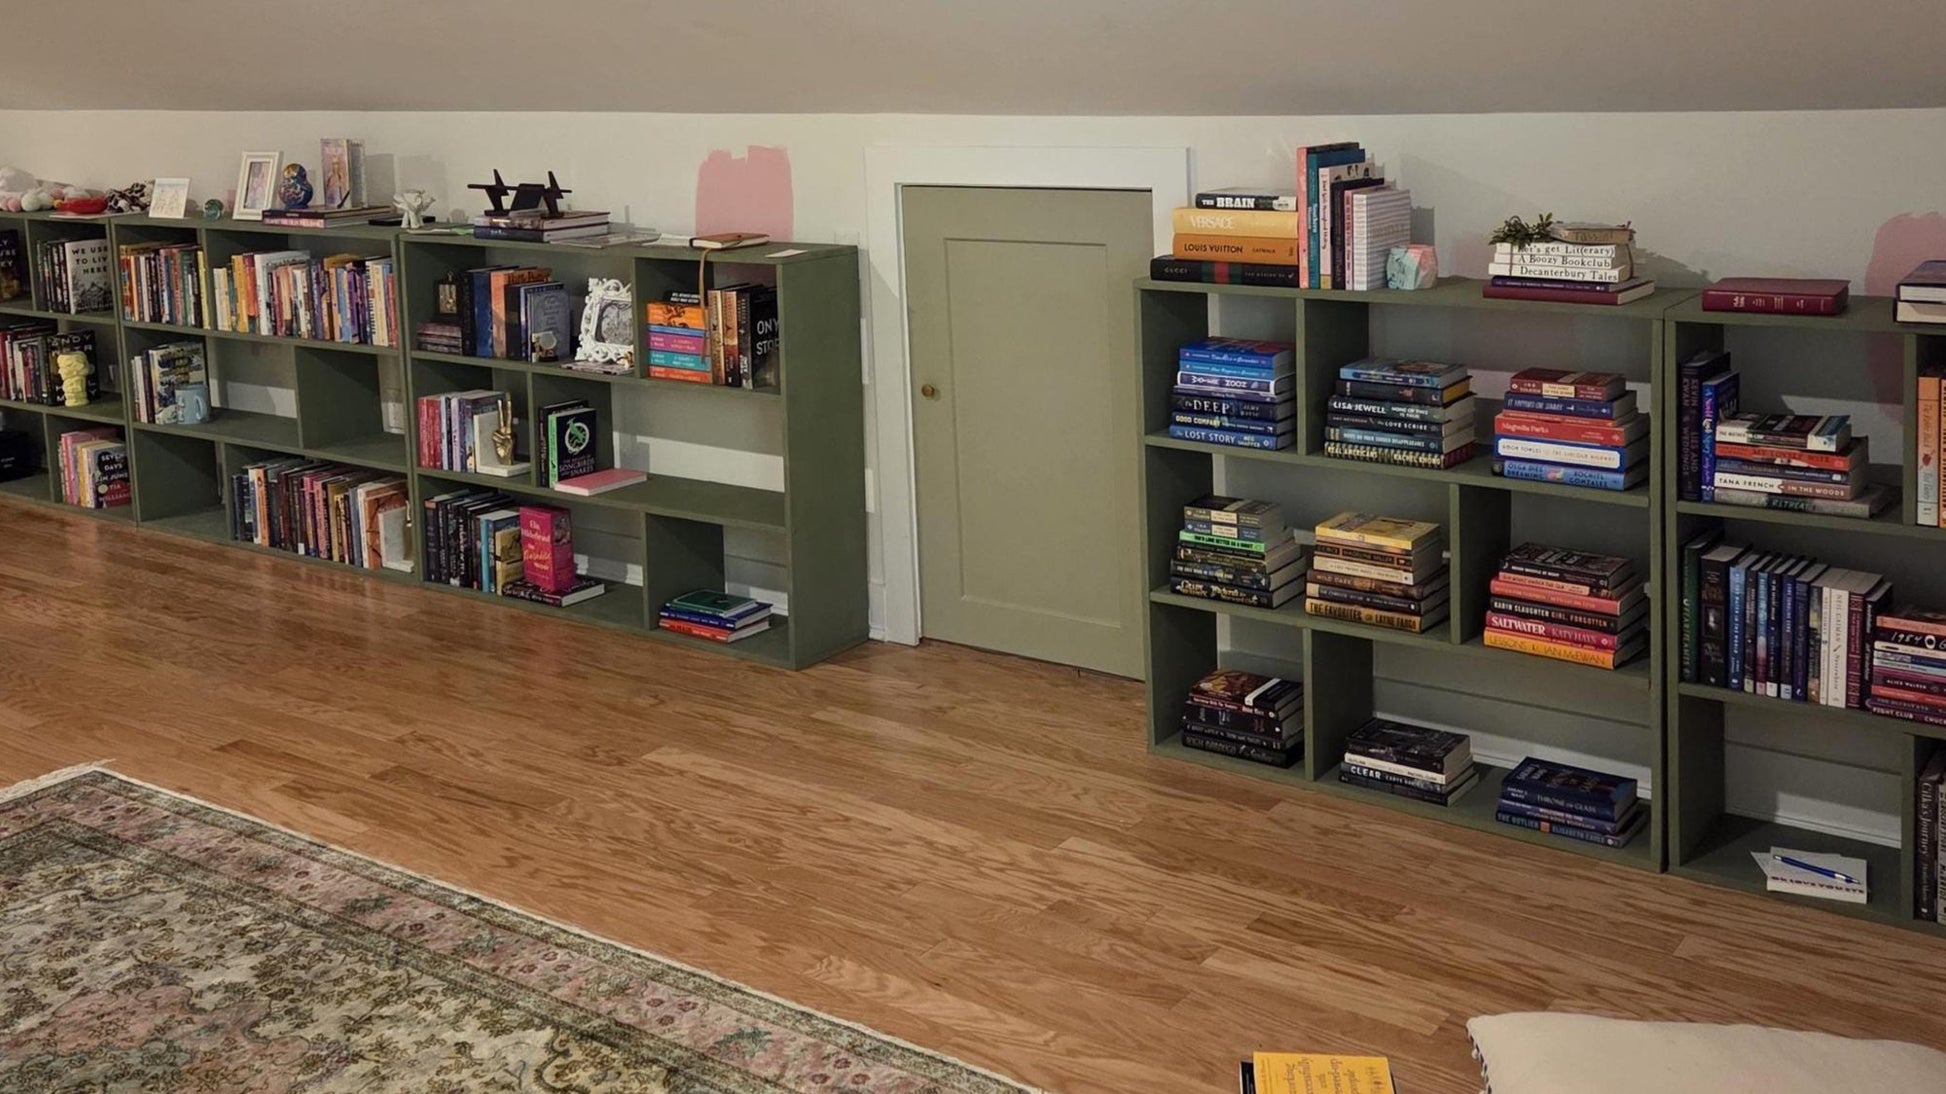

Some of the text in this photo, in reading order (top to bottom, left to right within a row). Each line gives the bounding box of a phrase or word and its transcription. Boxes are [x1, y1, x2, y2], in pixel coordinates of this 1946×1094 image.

[1216, 197, 1255, 209] BRAIN
[1190, 215, 1234, 229] VERSACE
[72, 246, 108, 255] WE USE
[1184, 243, 1208, 252] LOUIS
[1208, 244, 1243, 254] VUITTON
[1545, 246, 1560, 256] get
[1565, 245, 1615, 256] Lit(erary)
[1519, 255, 1611, 268] A Boozy Bookclub
[1520, 266, 1618, 281] Decanterbury Tales
[756, 339, 780, 355] STO
[1193, 400, 1230, 414] DEEP
[1333, 401, 1387, 414] LISA JEWELL
[1176, 415, 1192, 423] GOOD
[1194, 417, 1220, 427] COMPANY
[1185, 431, 1236, 444] LOST STORY
[1327, 447, 1378, 459] REAL AMERICANS
[1394, 453, 1418, 463] RACHEL
[1507, 469, 1543, 479] DREAMING
[1508, 463, 1543, 473] OLGA DIES
[1743, 480, 1775, 488] FRENCH
[1816, 487, 1845, 497] WOODS
[1772, 500, 1809, 510] RETREAT
[1310, 602, 1362, 620] THE FAVORITES
[1514, 604, 1550, 618] SLAUGHTER
[1570, 613, 1607, 627] FORGOTTEN
[1375, 614, 1417, 630] LAYNE FARGO
[1491, 616, 1597, 645] SALTWATER KATY HAYS
[1891, 632, 1923, 645] 1984
[1873, 707, 1914, 719] FIGHT CLUB
[1350, 766, 1382, 779] CLEAR
[1537, 795, 1565, 807] THRONE
[1574, 803, 1596, 813] GLASS
[1921, 782, 1932, 815] Cilka's
[1497, 813, 1539, 829] THE OUTLIER
[1920, 817, 1931, 855] Journey
